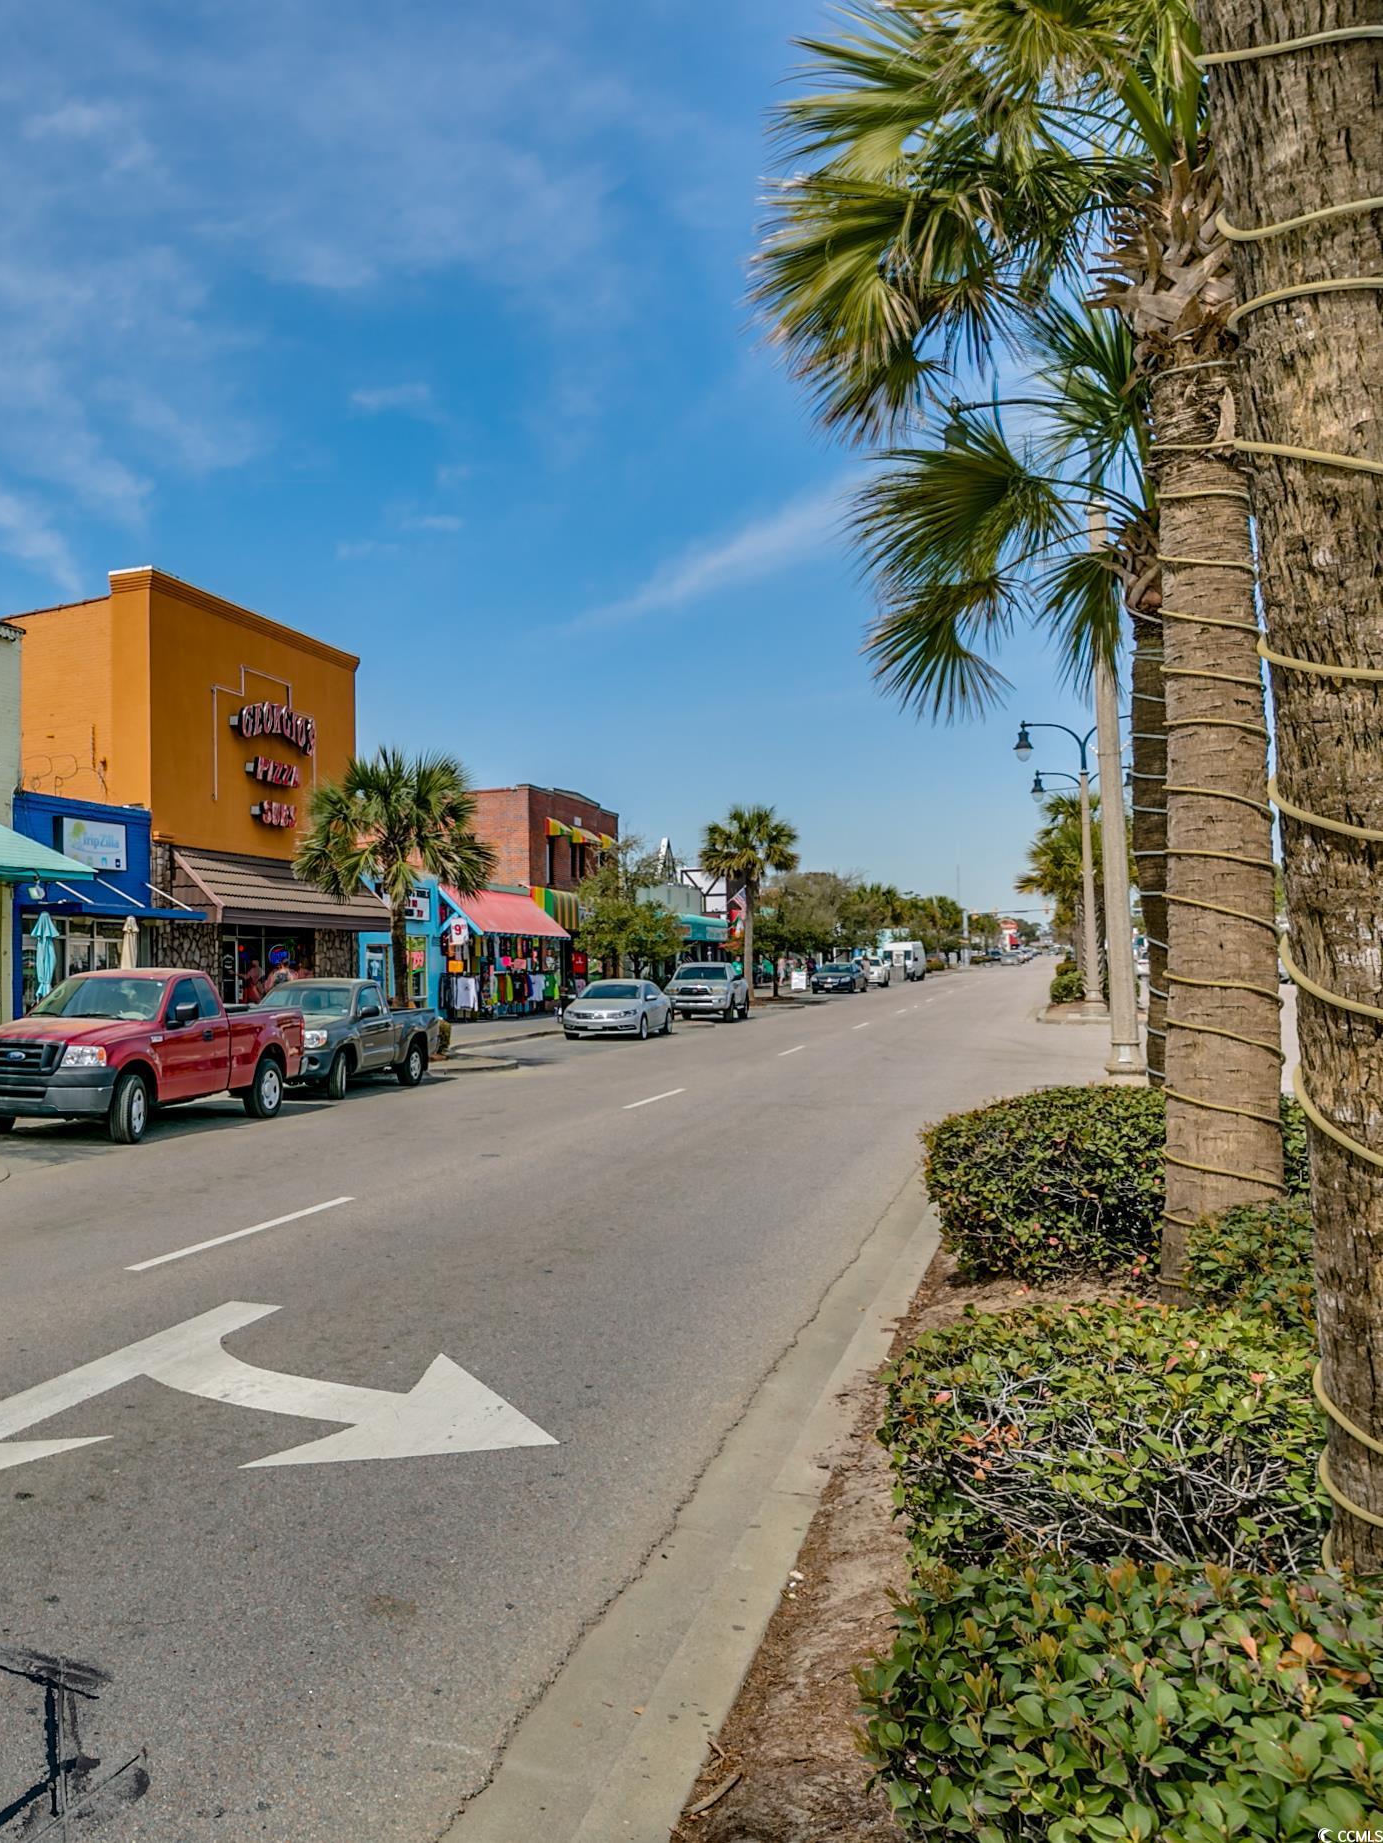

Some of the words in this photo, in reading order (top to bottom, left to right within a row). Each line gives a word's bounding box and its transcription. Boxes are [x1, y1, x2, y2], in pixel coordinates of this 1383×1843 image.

[240, 701, 316, 756] GEORGIO'S
[255, 756, 300, 788] PIZZA
[260, 800, 298, 828] SUBS
